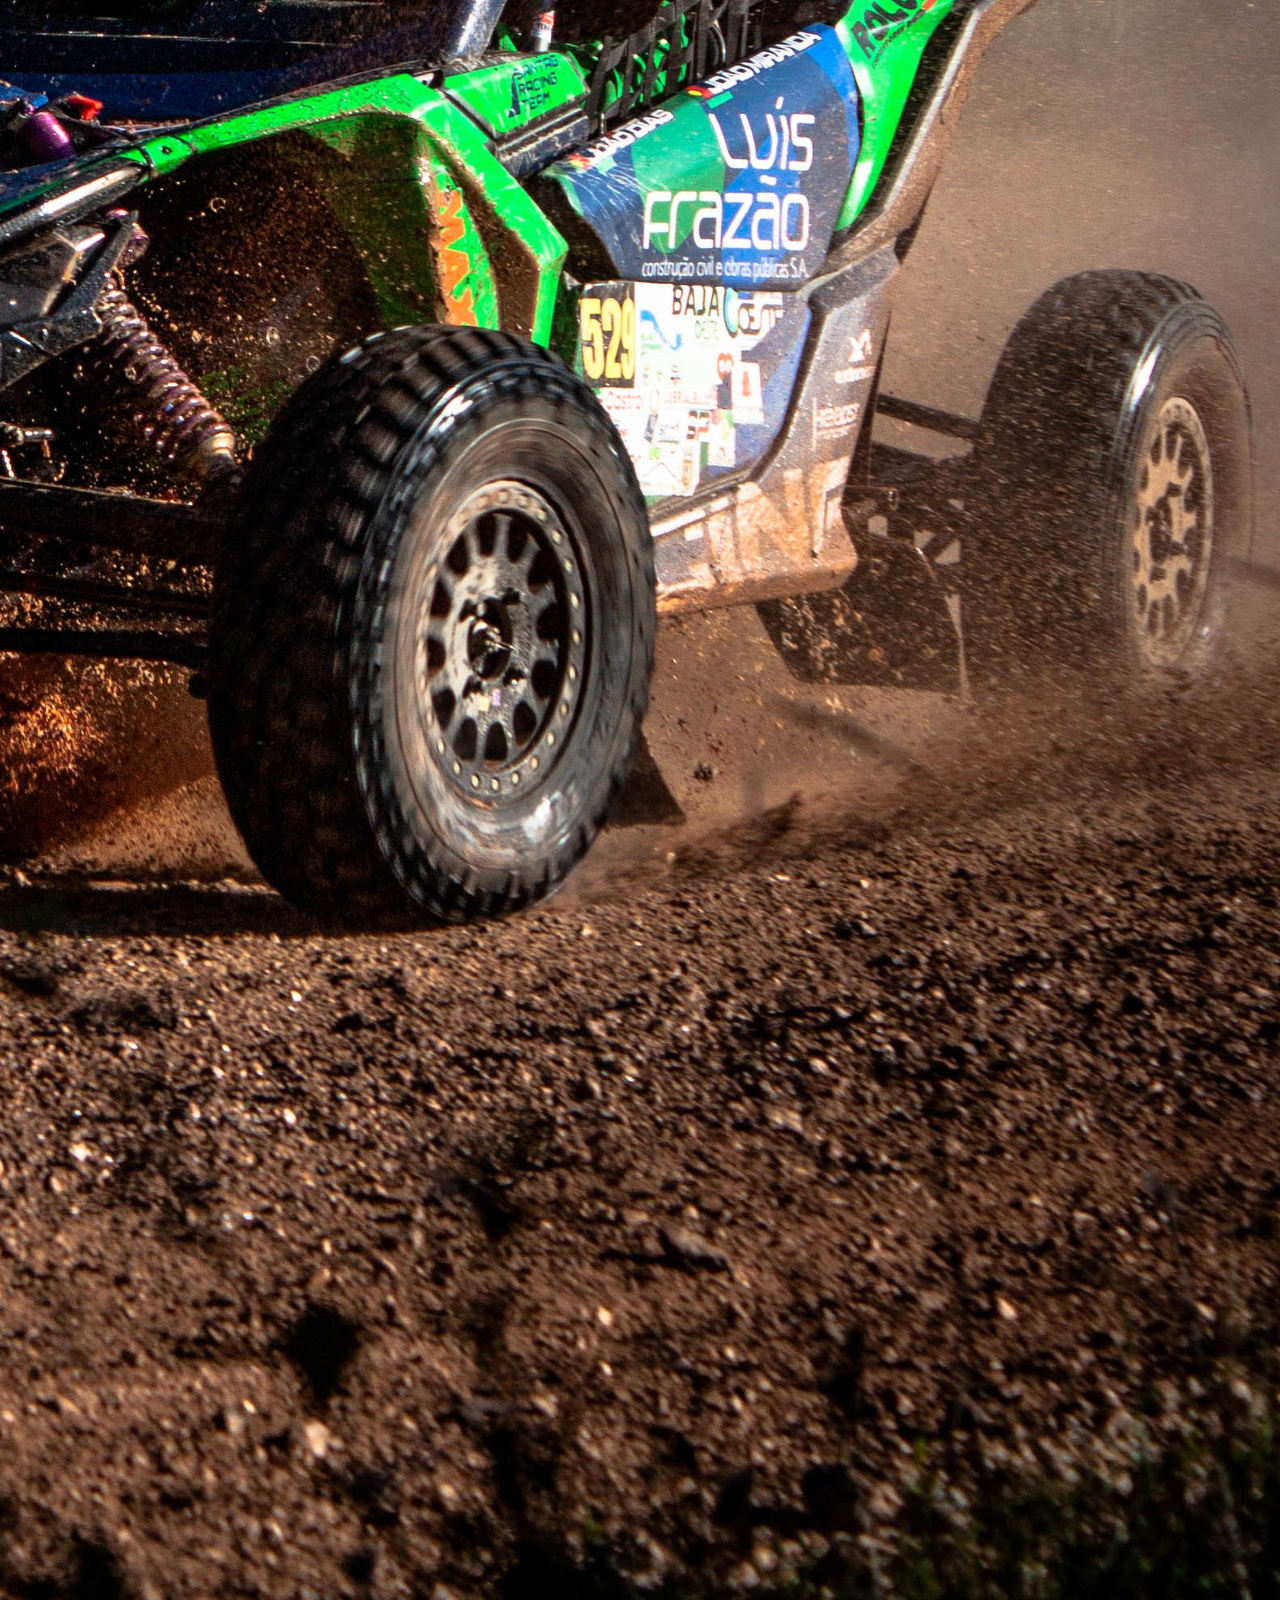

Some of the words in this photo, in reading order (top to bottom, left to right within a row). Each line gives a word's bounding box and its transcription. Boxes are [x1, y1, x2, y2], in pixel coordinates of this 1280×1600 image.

[741, 31, 823, 74] MIRANDA
[708, 96, 816, 172] LUÍS
[715, 261, 723, 277] e
[672, 285, 720, 317] BAJA
[579, 297, 635, 380] 529
